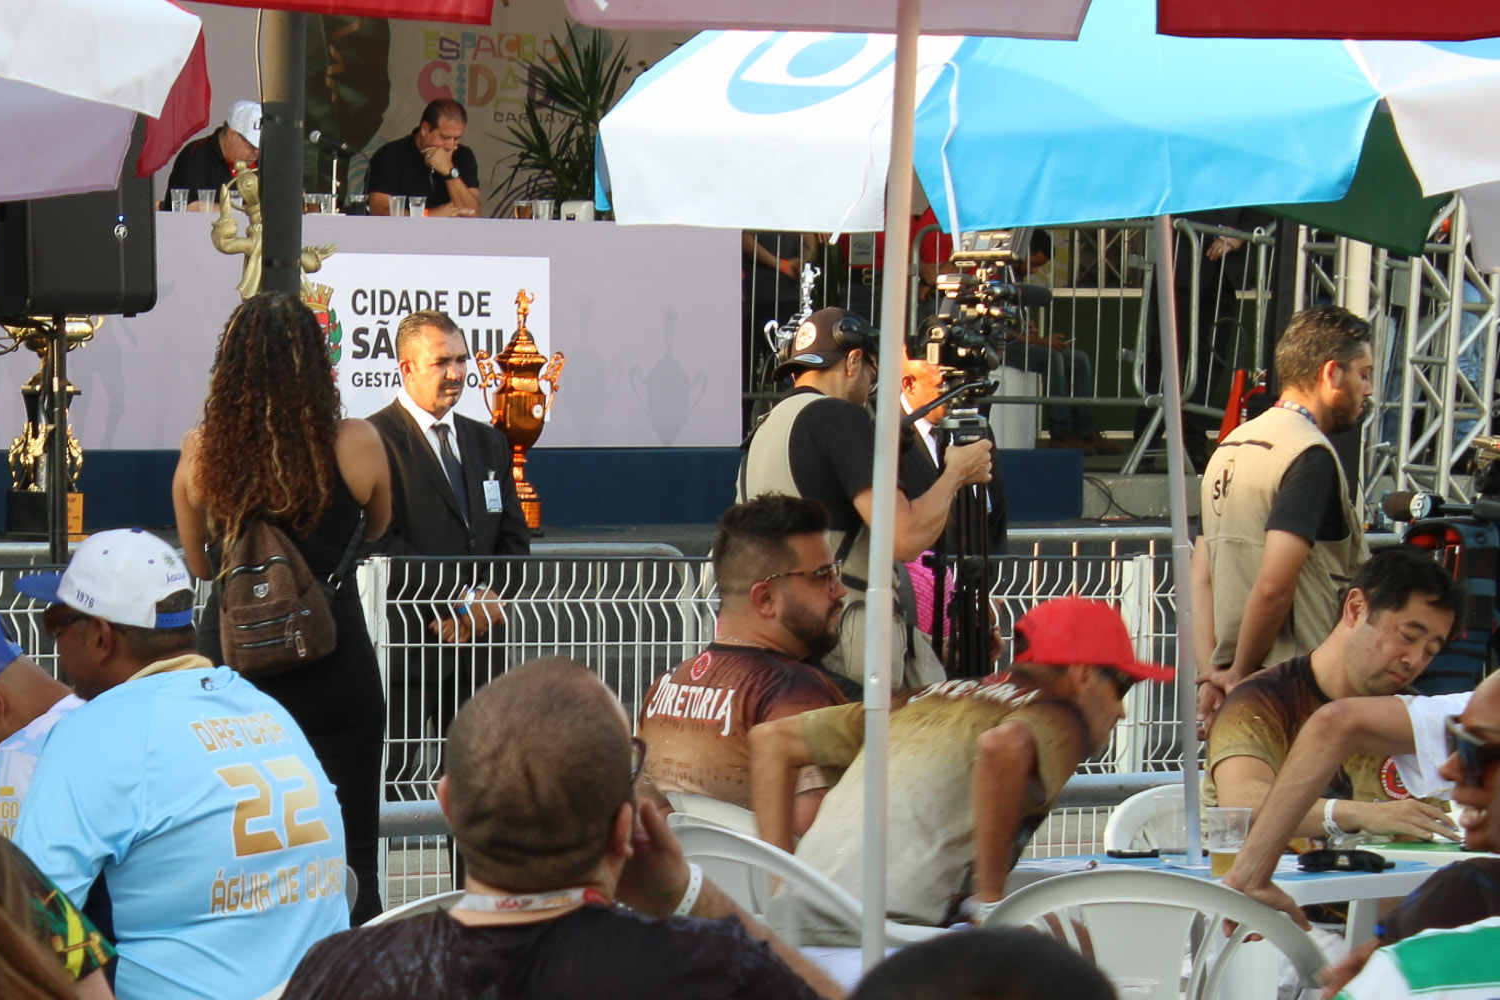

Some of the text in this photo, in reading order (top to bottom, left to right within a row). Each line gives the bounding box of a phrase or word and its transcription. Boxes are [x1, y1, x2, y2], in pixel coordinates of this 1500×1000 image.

[351, 288, 491, 318] CIDADE DE
[351, 320, 398, 360] SÃ
[646, 672, 737, 737] DIRETORIA
[214, 754, 331, 858] 22
[210, 868, 274, 915] ÁGUIA
[276, 866, 300, 905] DE
